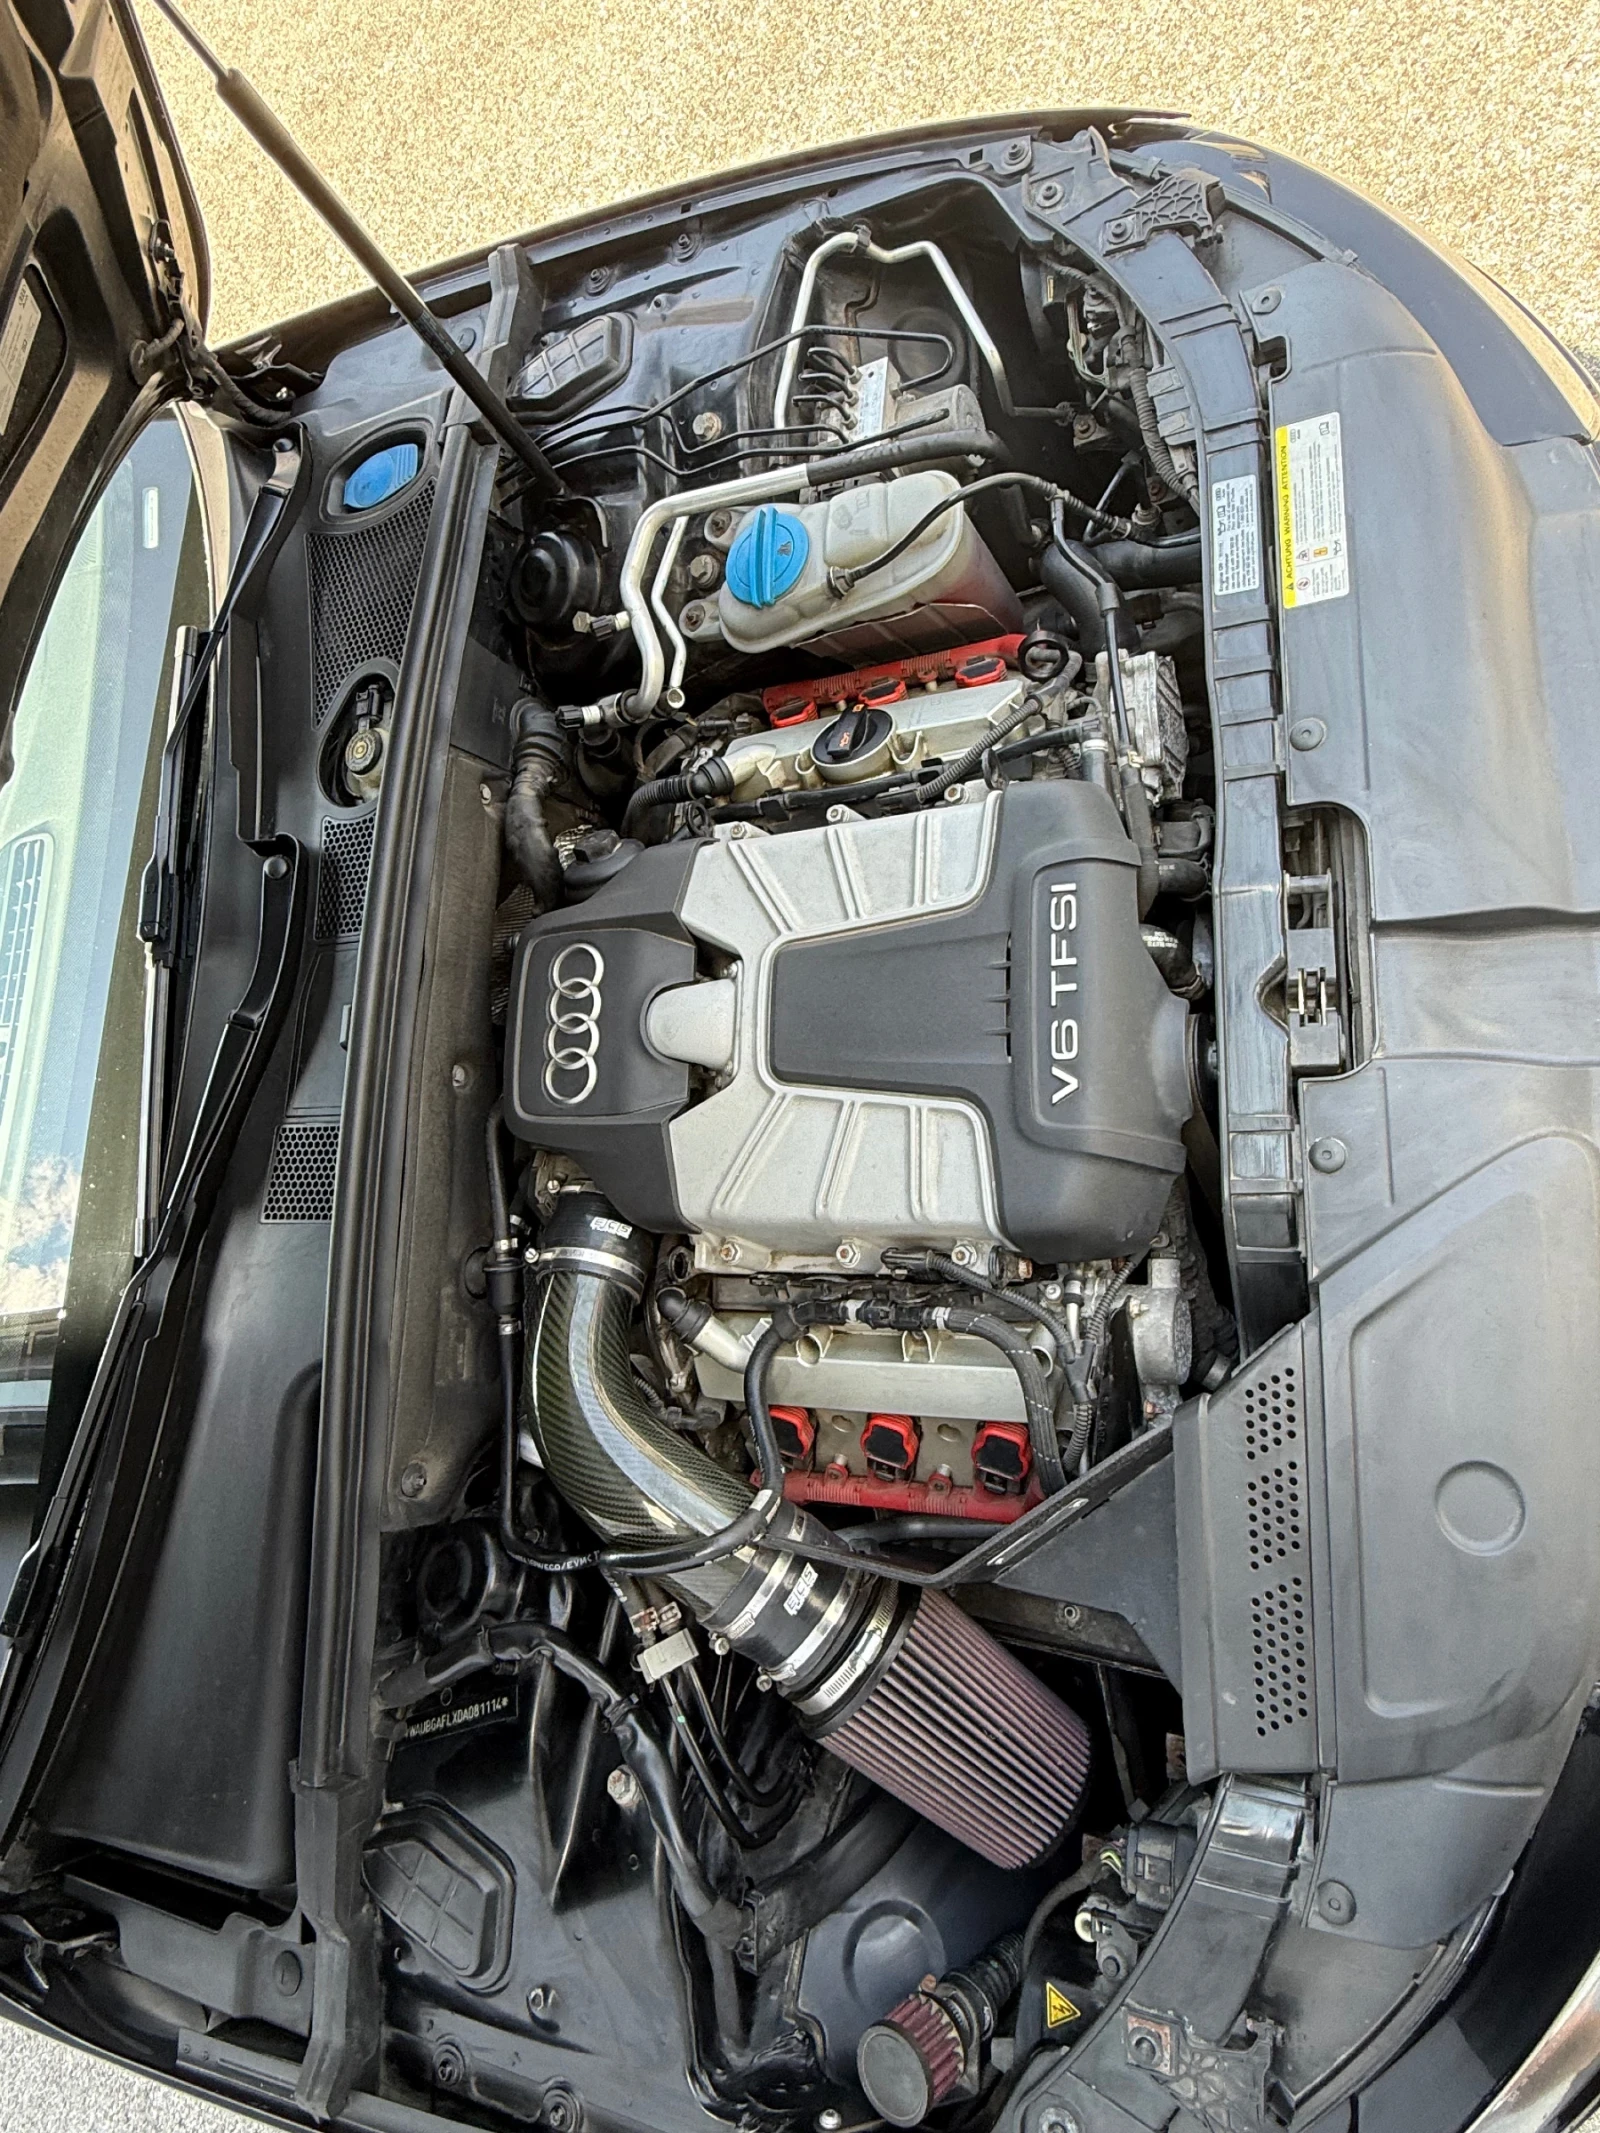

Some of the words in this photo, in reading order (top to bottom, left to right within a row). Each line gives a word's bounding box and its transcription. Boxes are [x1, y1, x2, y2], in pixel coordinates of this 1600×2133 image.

[1280, 445, 1289, 490] ATTENTION
[1281, 494, 1291, 536] WARNING
[1282, 538, 1293, 579] ACHTUNG
[1050, 882, 1078, 1007] TFSI
[1051, 1018, 1079, 1105] V6
[591, 1217, 632, 1236] ECS
[785, 1563, 815, 1613] ECS
